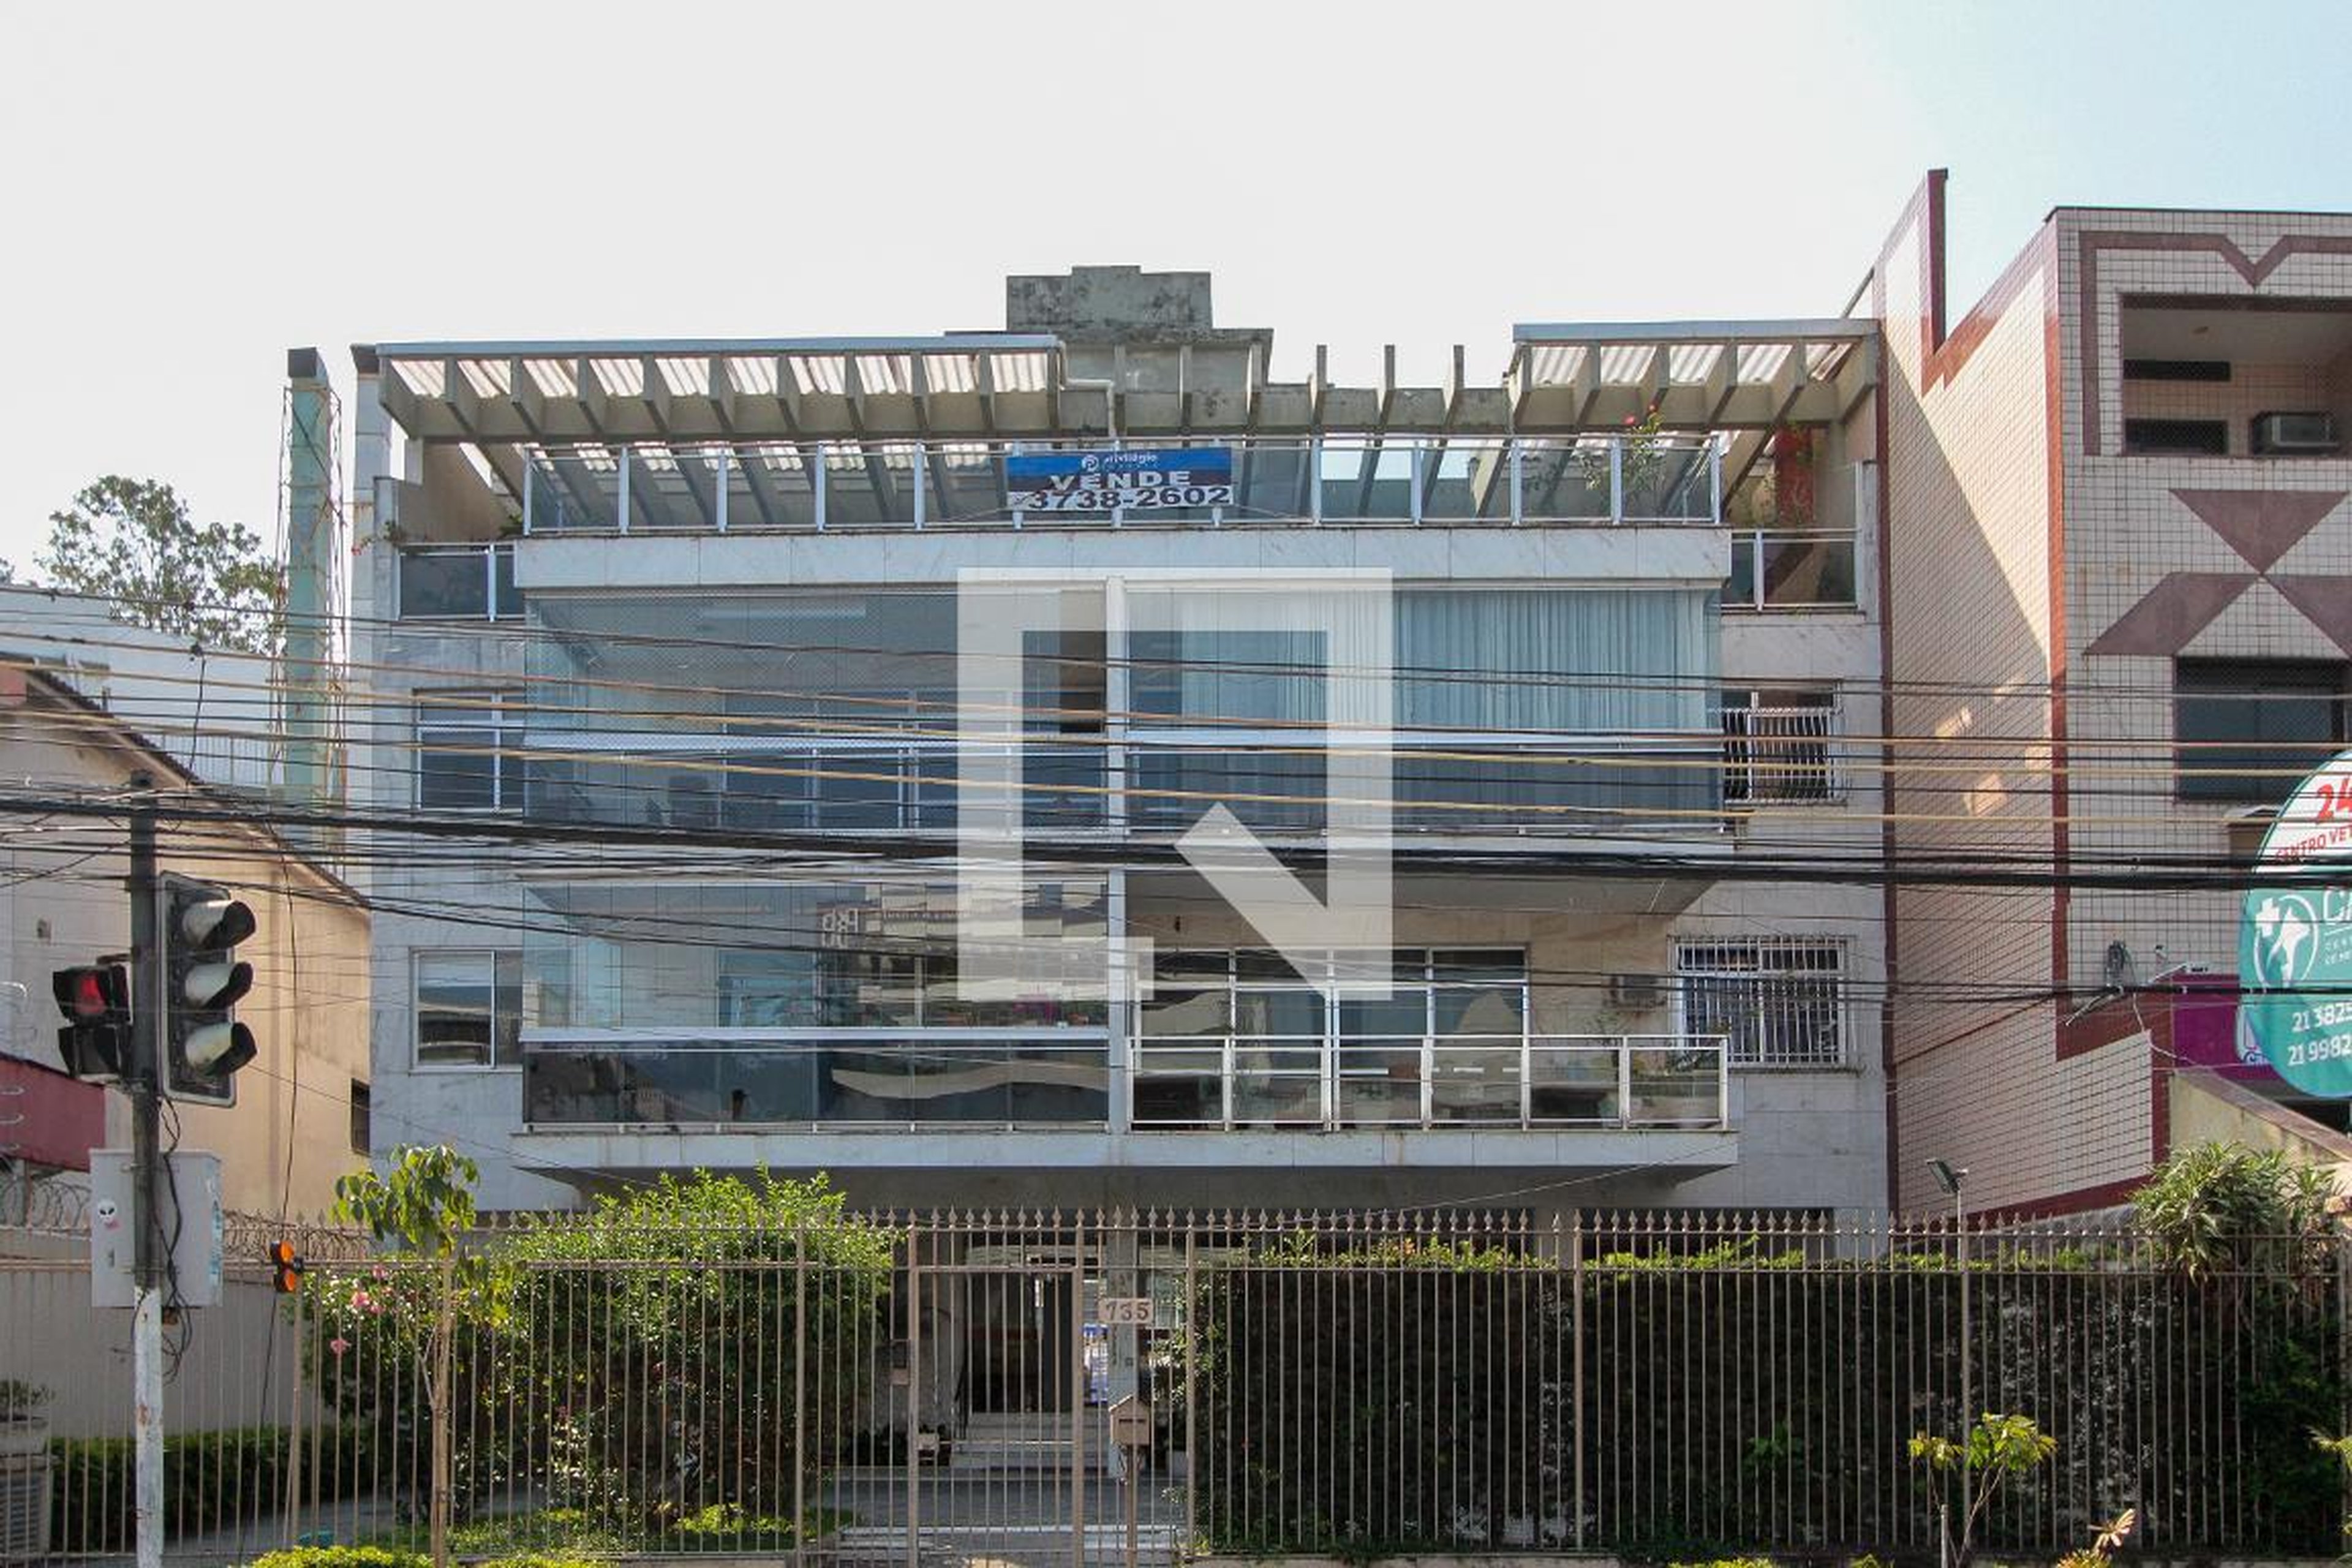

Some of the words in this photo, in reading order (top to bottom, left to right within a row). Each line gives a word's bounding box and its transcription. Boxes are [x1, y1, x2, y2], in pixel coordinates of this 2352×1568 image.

[1050, 470, 1191, 491] VENDE
[1028, 488, 1231, 509] 3738-2602
[2291, 1011, 2310, 1032] 21
[2288, 1044, 2305, 1066] 21
[1106, 1302, 1149, 1321] 735
